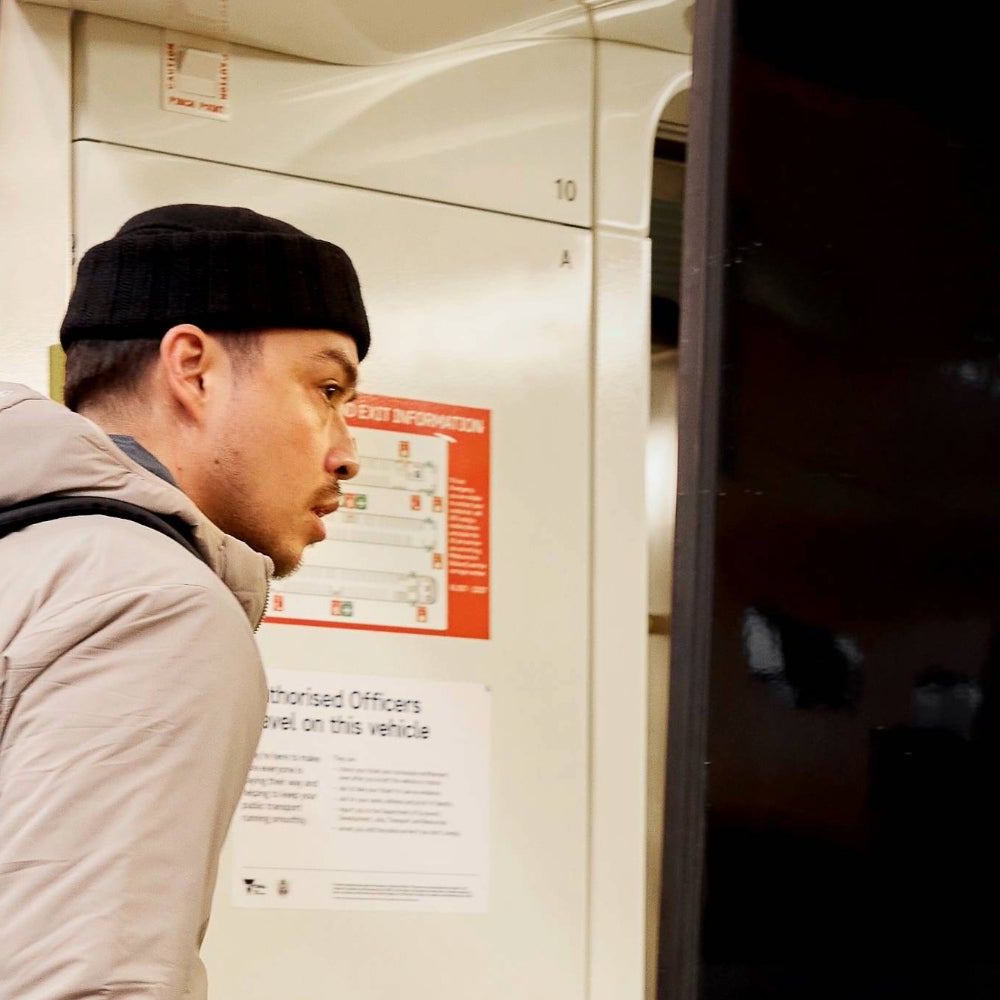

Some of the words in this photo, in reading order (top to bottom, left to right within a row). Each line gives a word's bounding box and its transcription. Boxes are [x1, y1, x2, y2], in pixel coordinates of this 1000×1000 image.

[554, 178, 578, 202] 10
[559, 248, 575, 270] A
[392, 408, 486, 434] INFORMATION
[266, 685, 345, 709] thorised
[349, 691, 421, 714] Officers
[303, 717, 325, 733] on
[330, 715, 362, 736] this
[368, 719, 430, 740] vehicle
